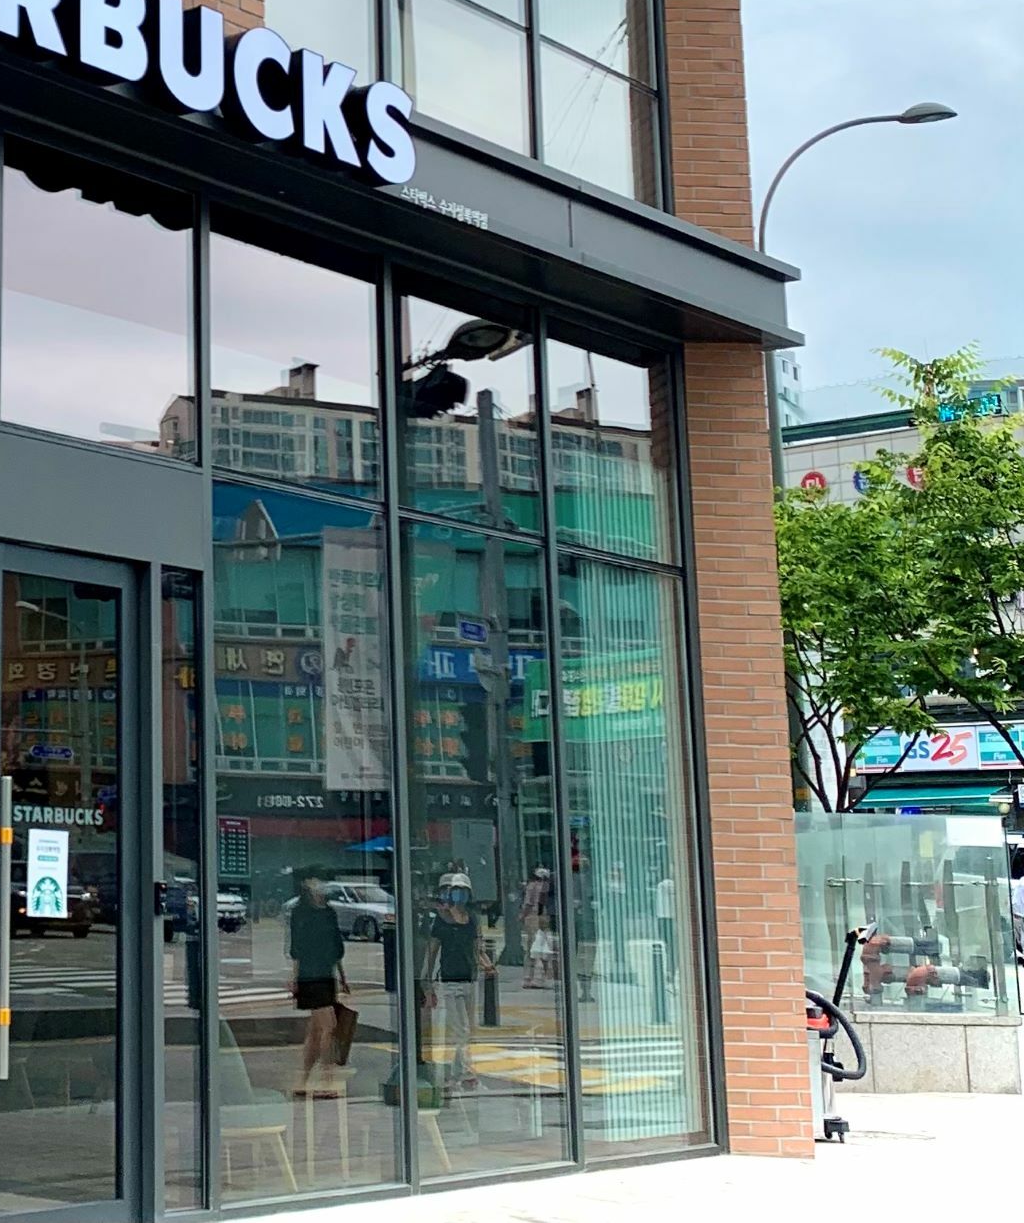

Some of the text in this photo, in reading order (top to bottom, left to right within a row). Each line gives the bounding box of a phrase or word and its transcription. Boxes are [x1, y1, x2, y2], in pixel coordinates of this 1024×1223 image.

[400, 185, 437, 209] 스타벅스
[904, 730, 972, 766] GS25
[13, 805, 104, 826] STARBUCKS
